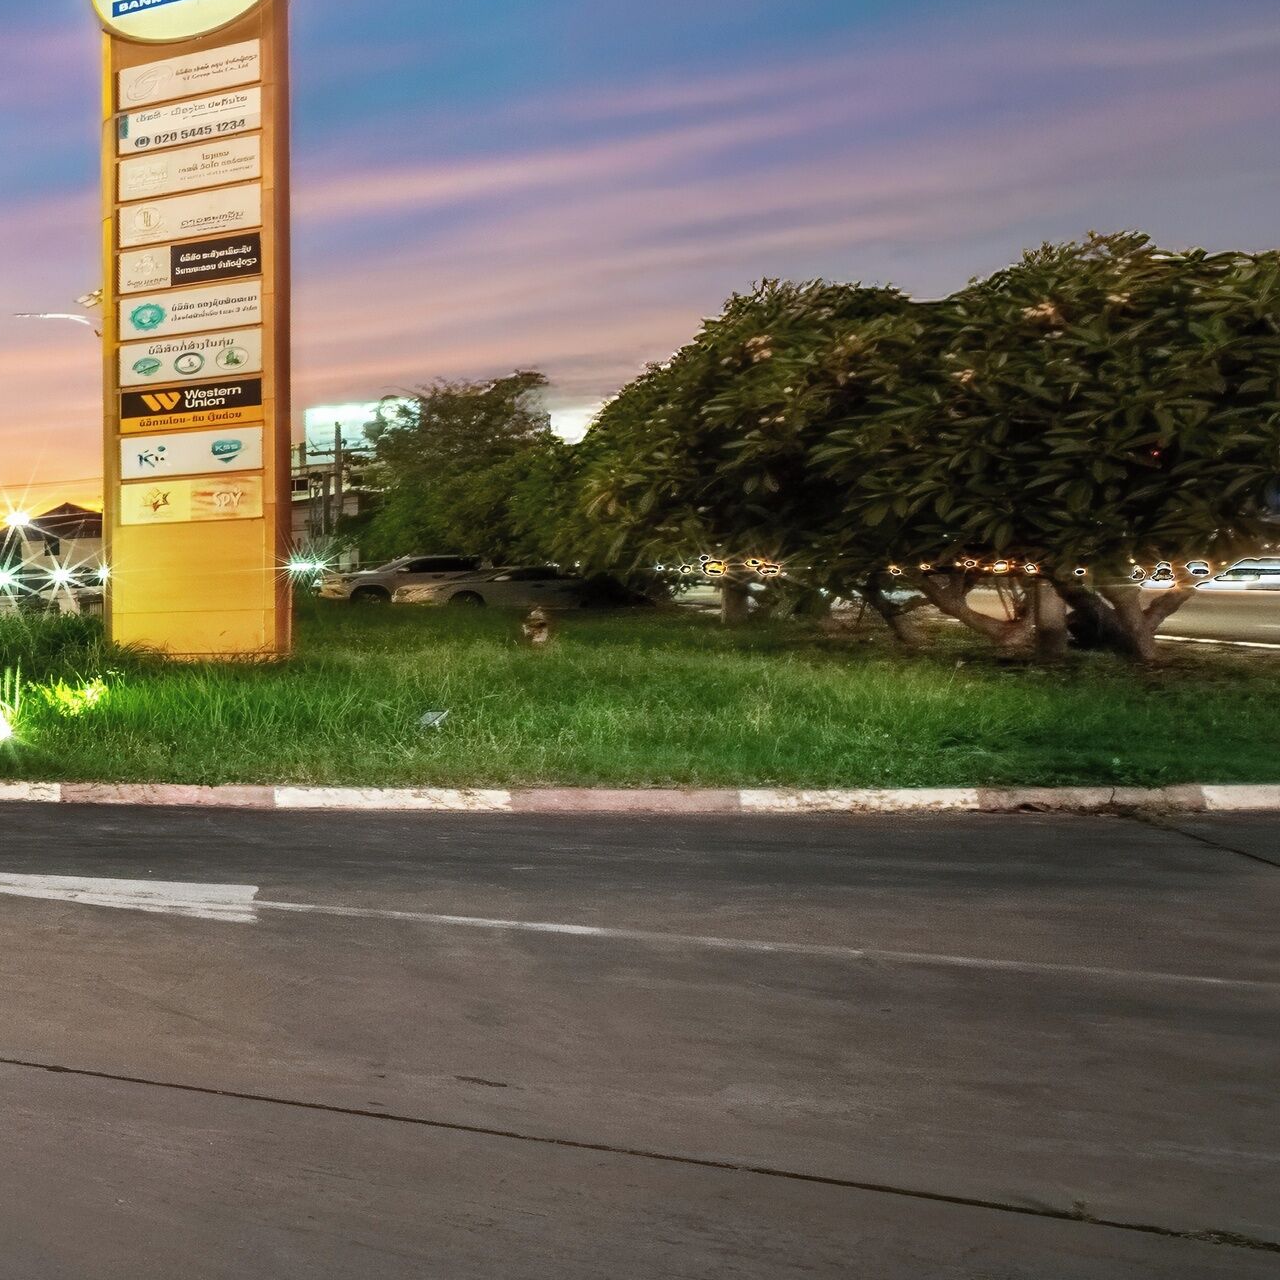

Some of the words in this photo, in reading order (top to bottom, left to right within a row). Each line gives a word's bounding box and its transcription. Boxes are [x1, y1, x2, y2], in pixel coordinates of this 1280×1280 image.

[154, 131, 177, 145] 020
[180, 125, 212, 139] 5445
[215, 118, 246, 132] 1234
[184, 386, 242, 399] Western
[184, 396, 225, 409] Union
